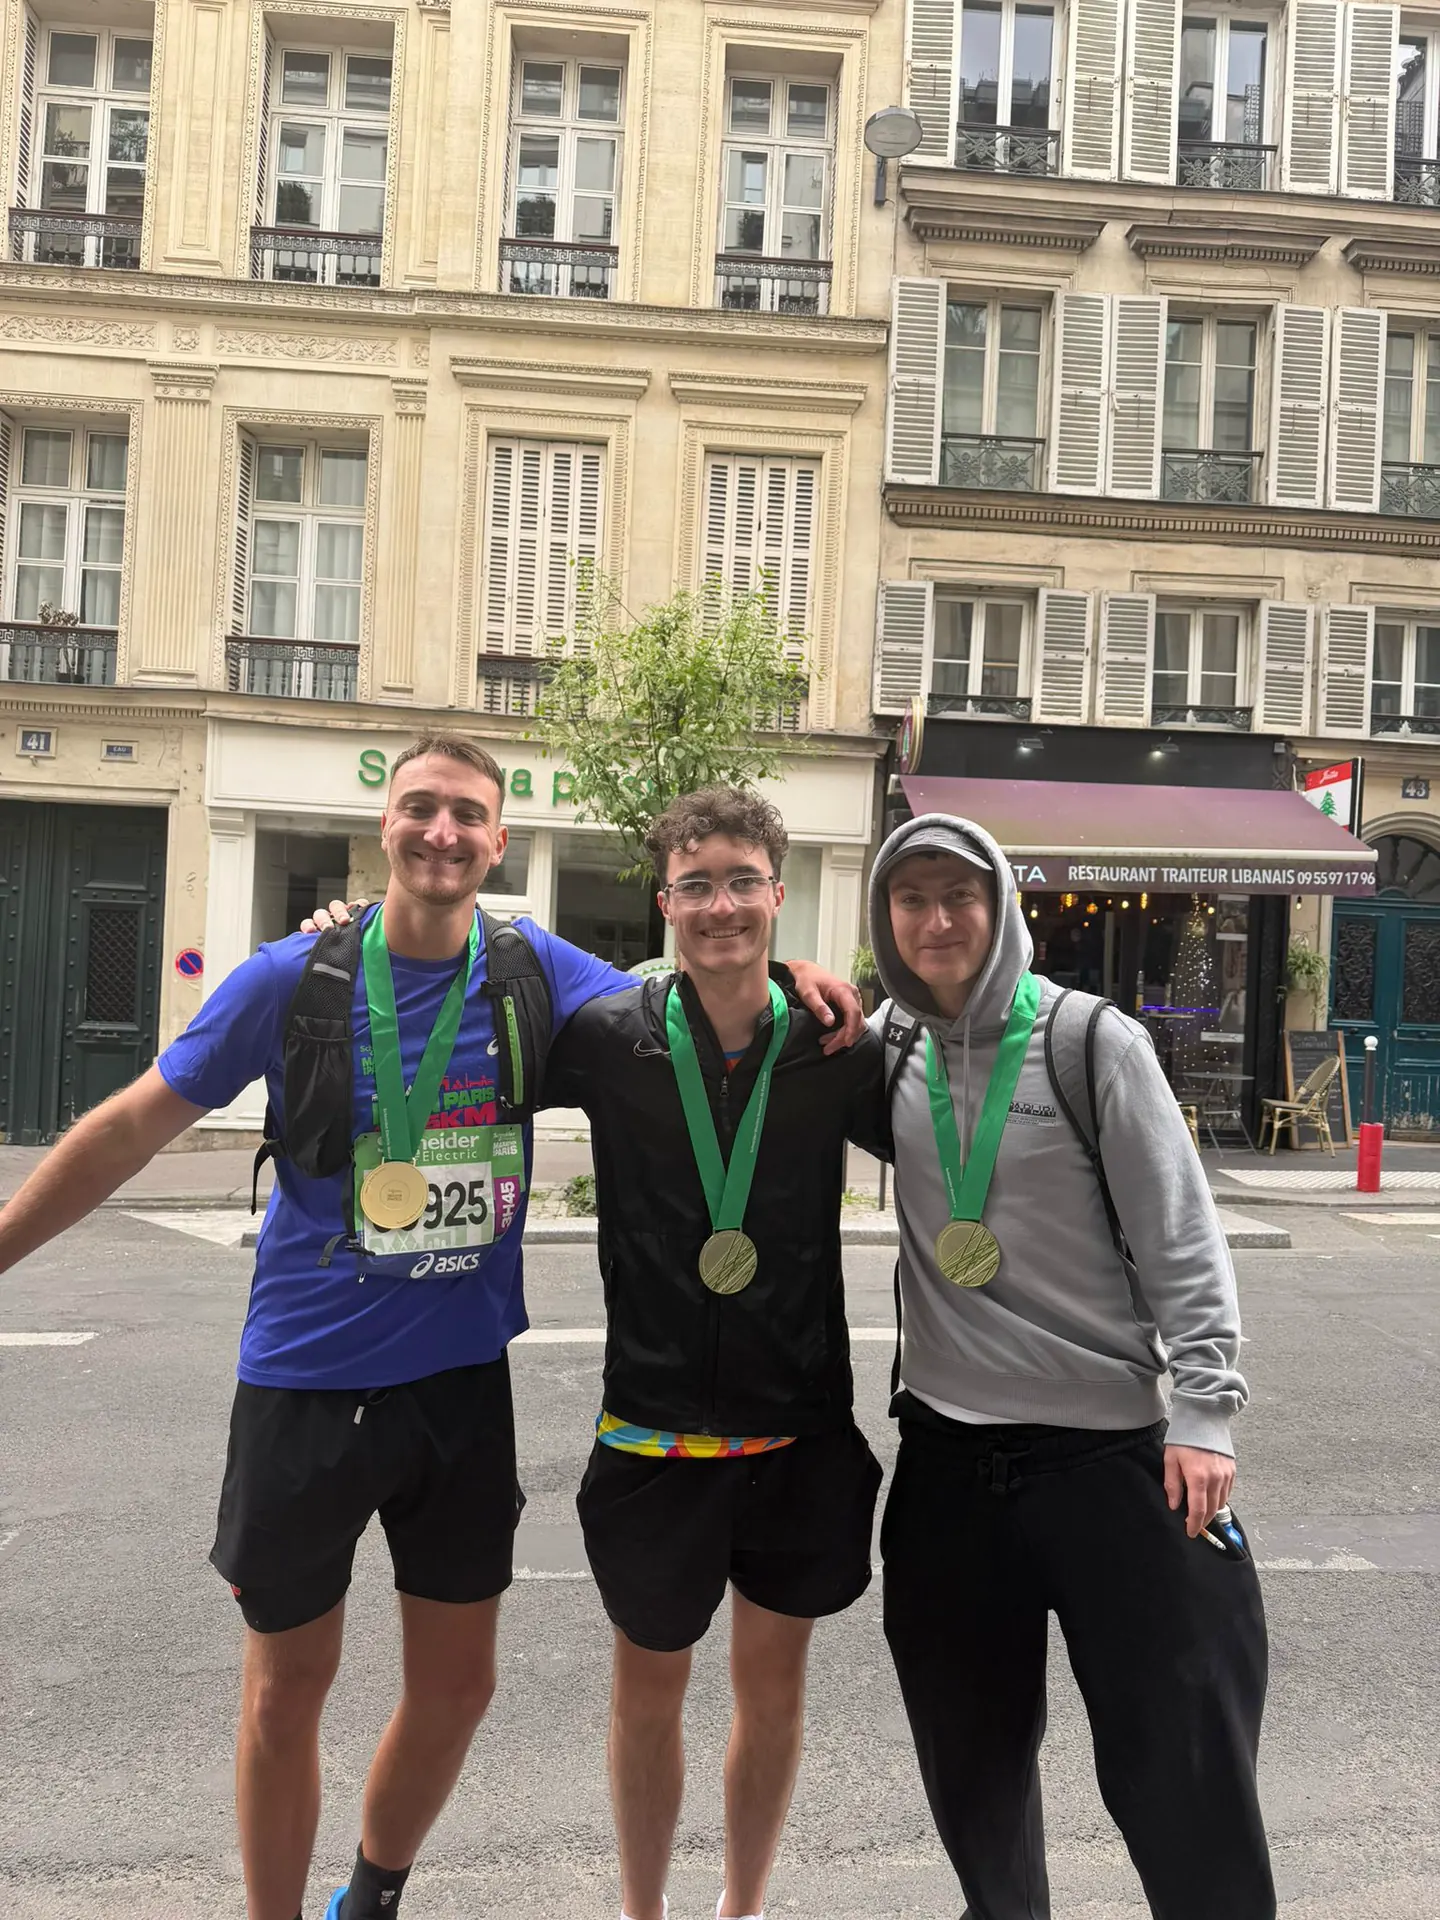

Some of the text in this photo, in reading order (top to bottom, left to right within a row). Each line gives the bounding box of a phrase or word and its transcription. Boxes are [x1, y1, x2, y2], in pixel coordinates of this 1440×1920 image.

[26, 733, 46, 750] 41
[1405, 780, 1426, 797] 43
[1008, 862, 1047, 883] TA
[1068, 865, 1158, 882] RESTAURANT
[1161, 867, 1228, 883] TRAITEUR
[1232, 868, 1295, 885] LIBANAIS
[443, 1086, 495, 1110] PARIS
[422, 1148, 478, 1162] Electric
[373, 1180, 488, 1234] 925
[500, 1181, 516, 1229] 3H45
